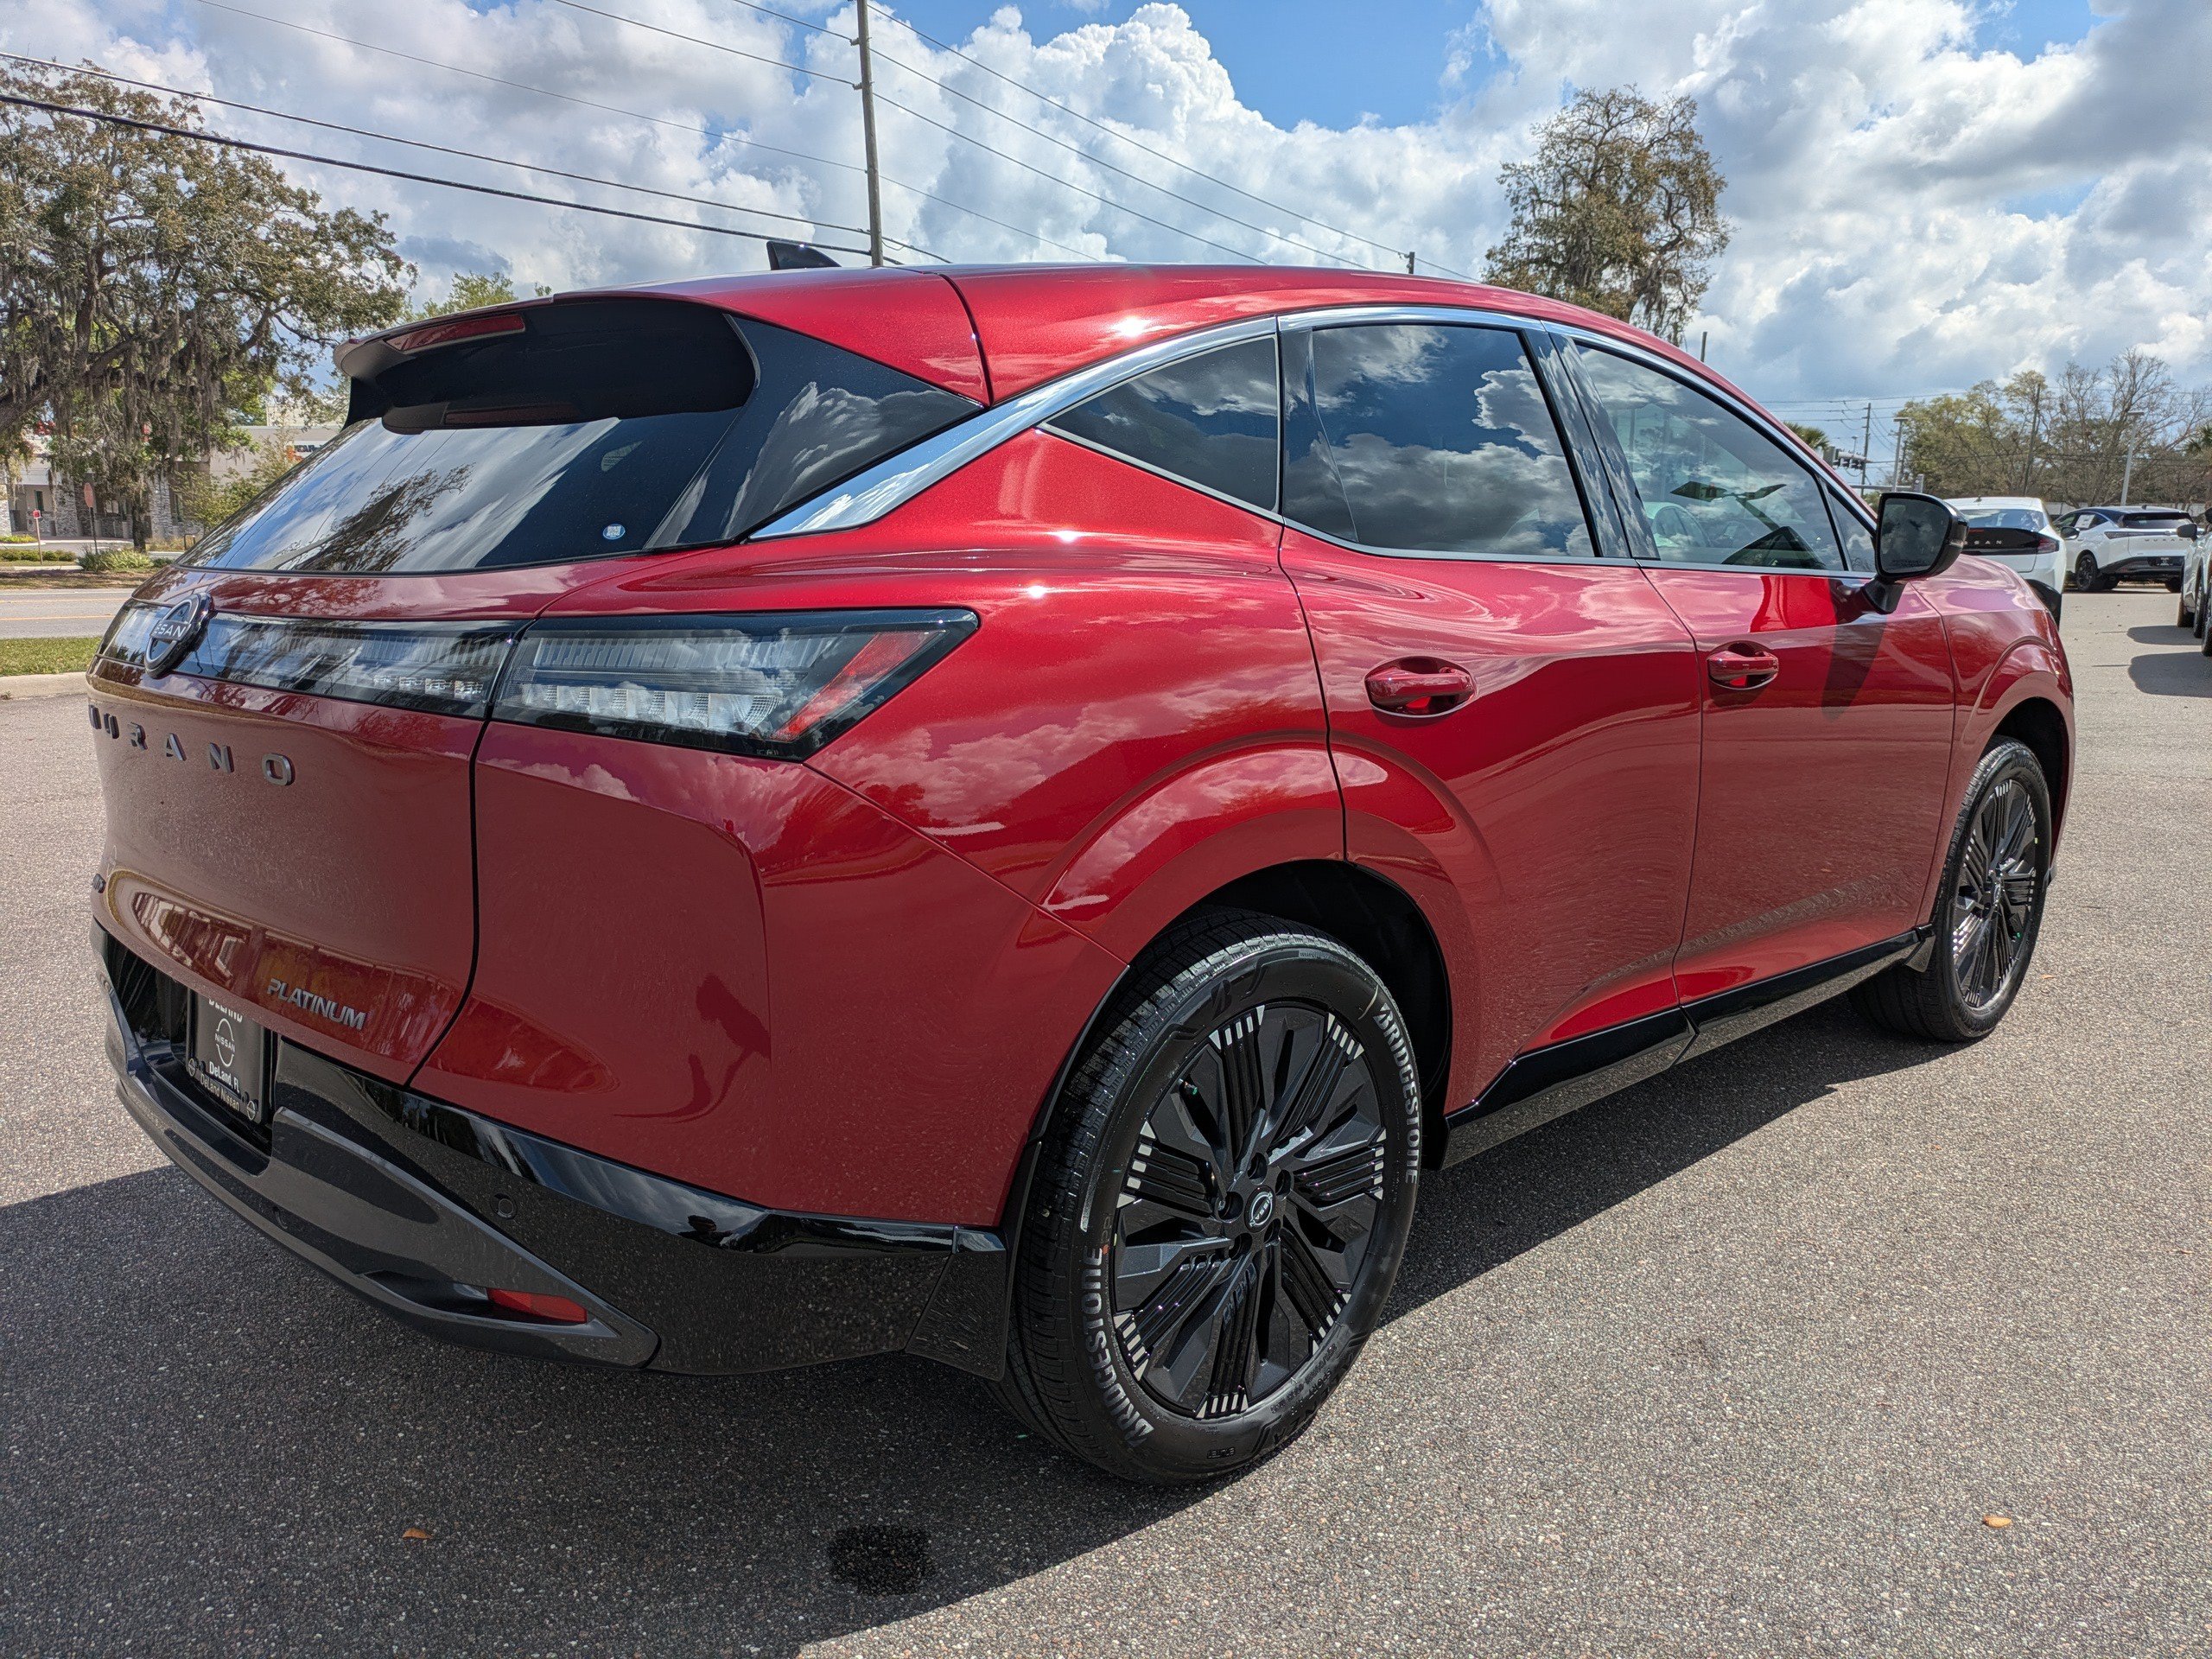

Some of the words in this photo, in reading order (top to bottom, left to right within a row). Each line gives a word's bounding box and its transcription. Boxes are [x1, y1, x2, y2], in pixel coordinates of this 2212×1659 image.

[266, 977, 366, 1032] PLATINUM
[214, 1032, 236, 1052] NISSAN
[200, 1072, 220, 1097] DeLand
[220, 1088, 240, 1112] Nissan
[1372, 1002, 1421, 1185] BRIDGESTONE
[1082, 1248, 1154, 1447] BRIDGESTONE
